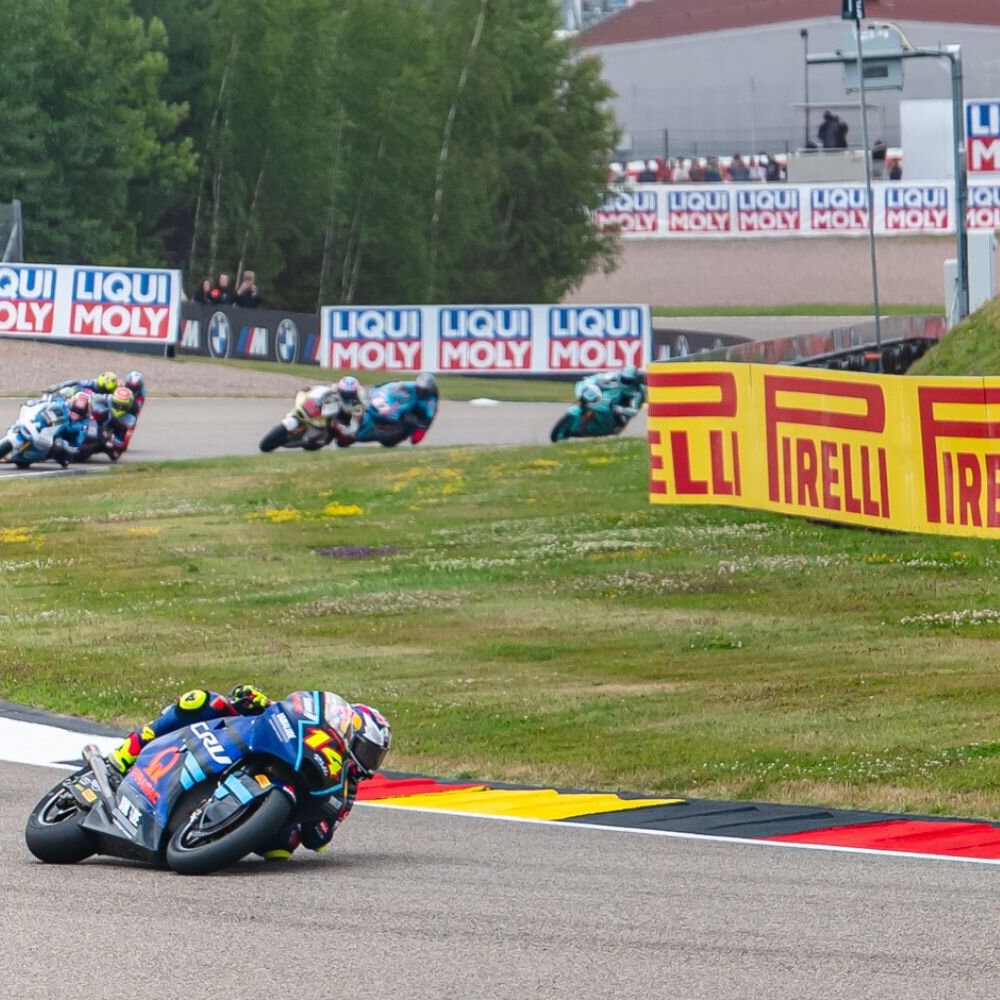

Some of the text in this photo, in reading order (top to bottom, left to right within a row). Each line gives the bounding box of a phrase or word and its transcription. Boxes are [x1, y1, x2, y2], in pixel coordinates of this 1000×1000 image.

[670, 191, 728, 212] LIQUI
[740, 190, 797, 211] LIQUI
[887, 187, 946, 209] LIQUI
[670, 212, 729, 231] MOLY
[740, 211, 799, 230] MOLY
[887, 208, 946, 229] MOLY
[77, 271, 167, 303] LIQUI
[73, 304, 168, 337] MOLY
[333, 310, 418, 338] LIQUI
[441, 309, 528, 338] LIQUI
[551, 308, 638, 338] LIQUI
[332, 341, 421, 369] MOLY
[441, 340, 530, 369] MOLY
[551, 339, 642, 367] MOLY
[764, 375, 890, 519] PIRELLI
[190, 721, 233, 765] CRU
[304, 729, 345, 777] 14
